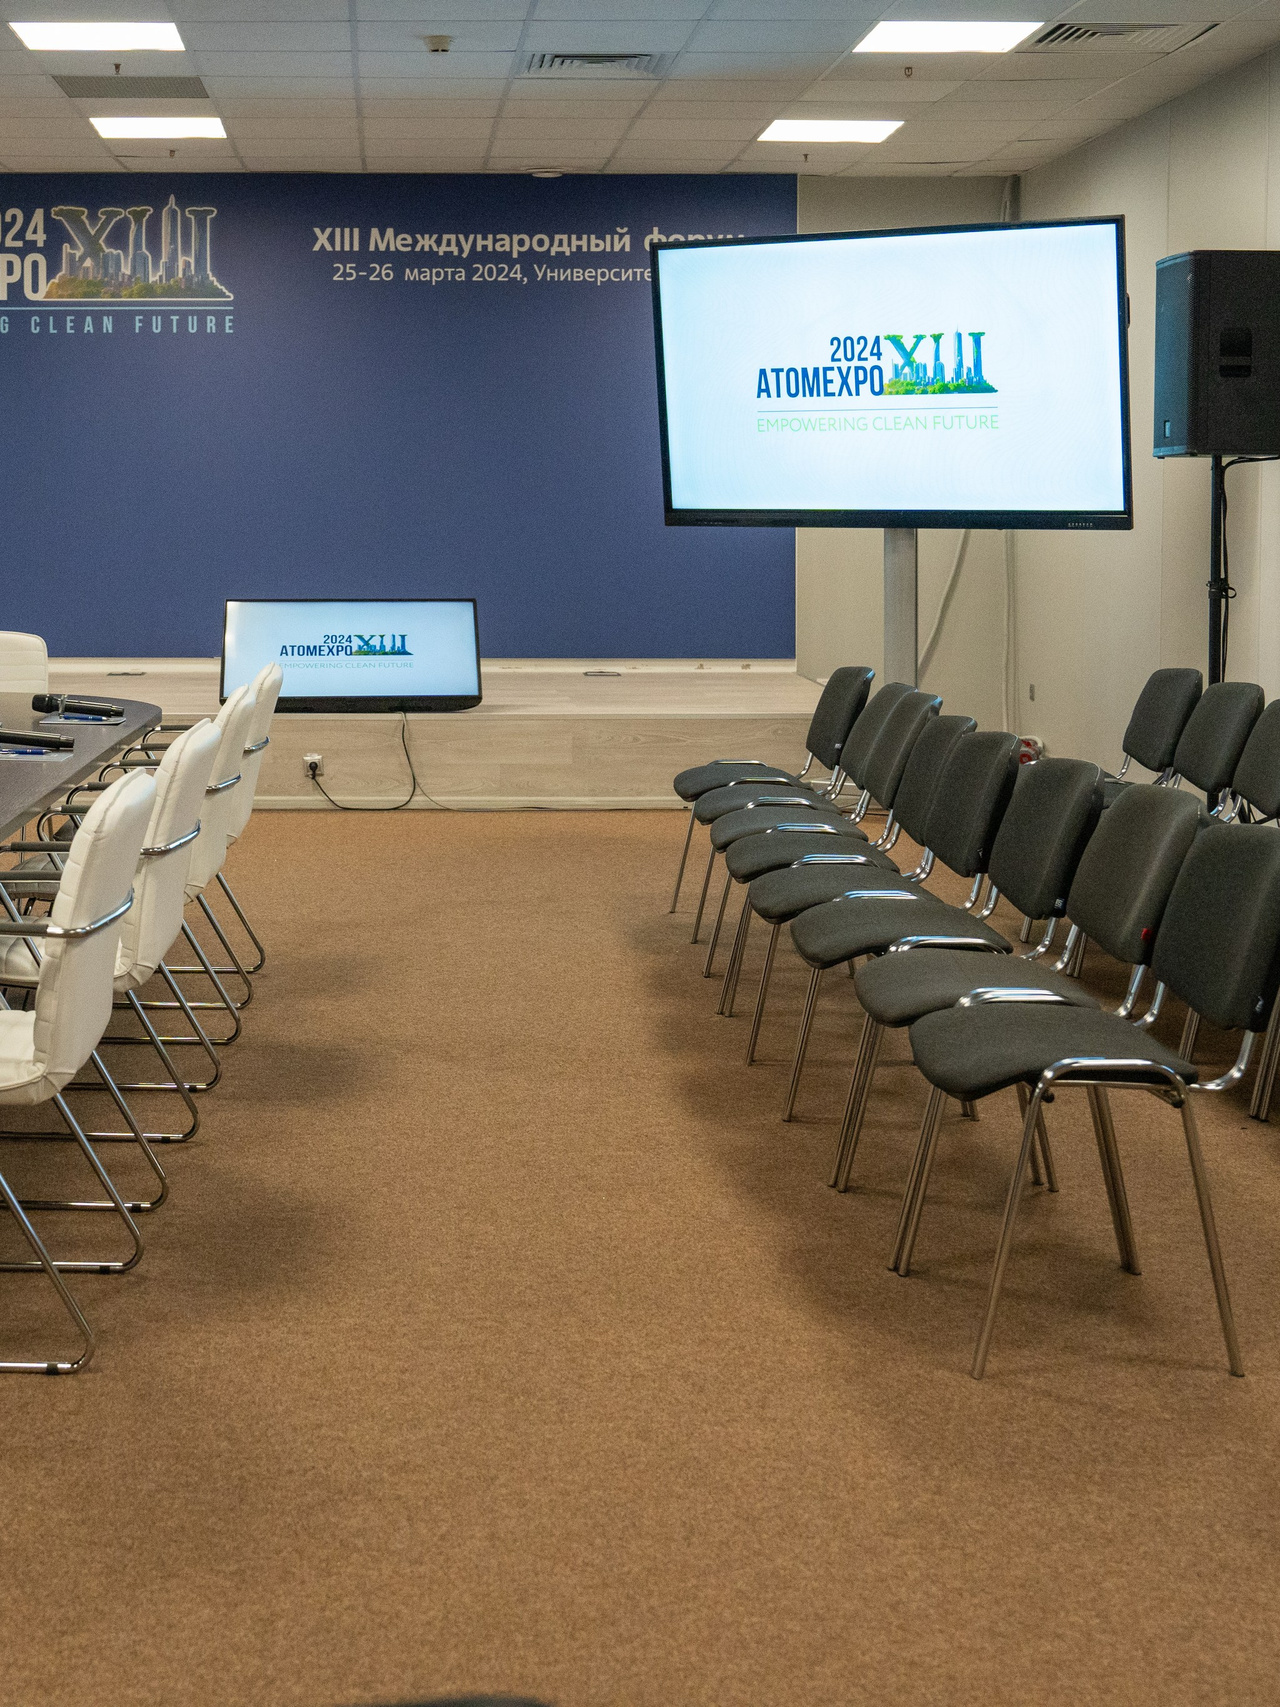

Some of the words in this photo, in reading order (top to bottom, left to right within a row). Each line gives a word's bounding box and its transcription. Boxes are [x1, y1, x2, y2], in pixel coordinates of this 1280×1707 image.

[369, 226, 631, 259] Международный
[332, 263, 394, 281] 25-26
[404, 267, 466, 286] марта
[472, 263, 528, 285] 2024,
[30, 316, 113, 334] CLEAN
[135, 316, 235, 334] FUTURE
[830, 335, 883, 363] 2024
[756, 364, 885, 399] ATOMEXPO
[757, 415, 869, 433] EMPOWERING
[872, 414, 928, 431] CLEAN
[932, 414, 1000, 431] FUTURE
[323, 634, 353, 645] 2024
[279, 644, 353, 657] ATOMEXPO
